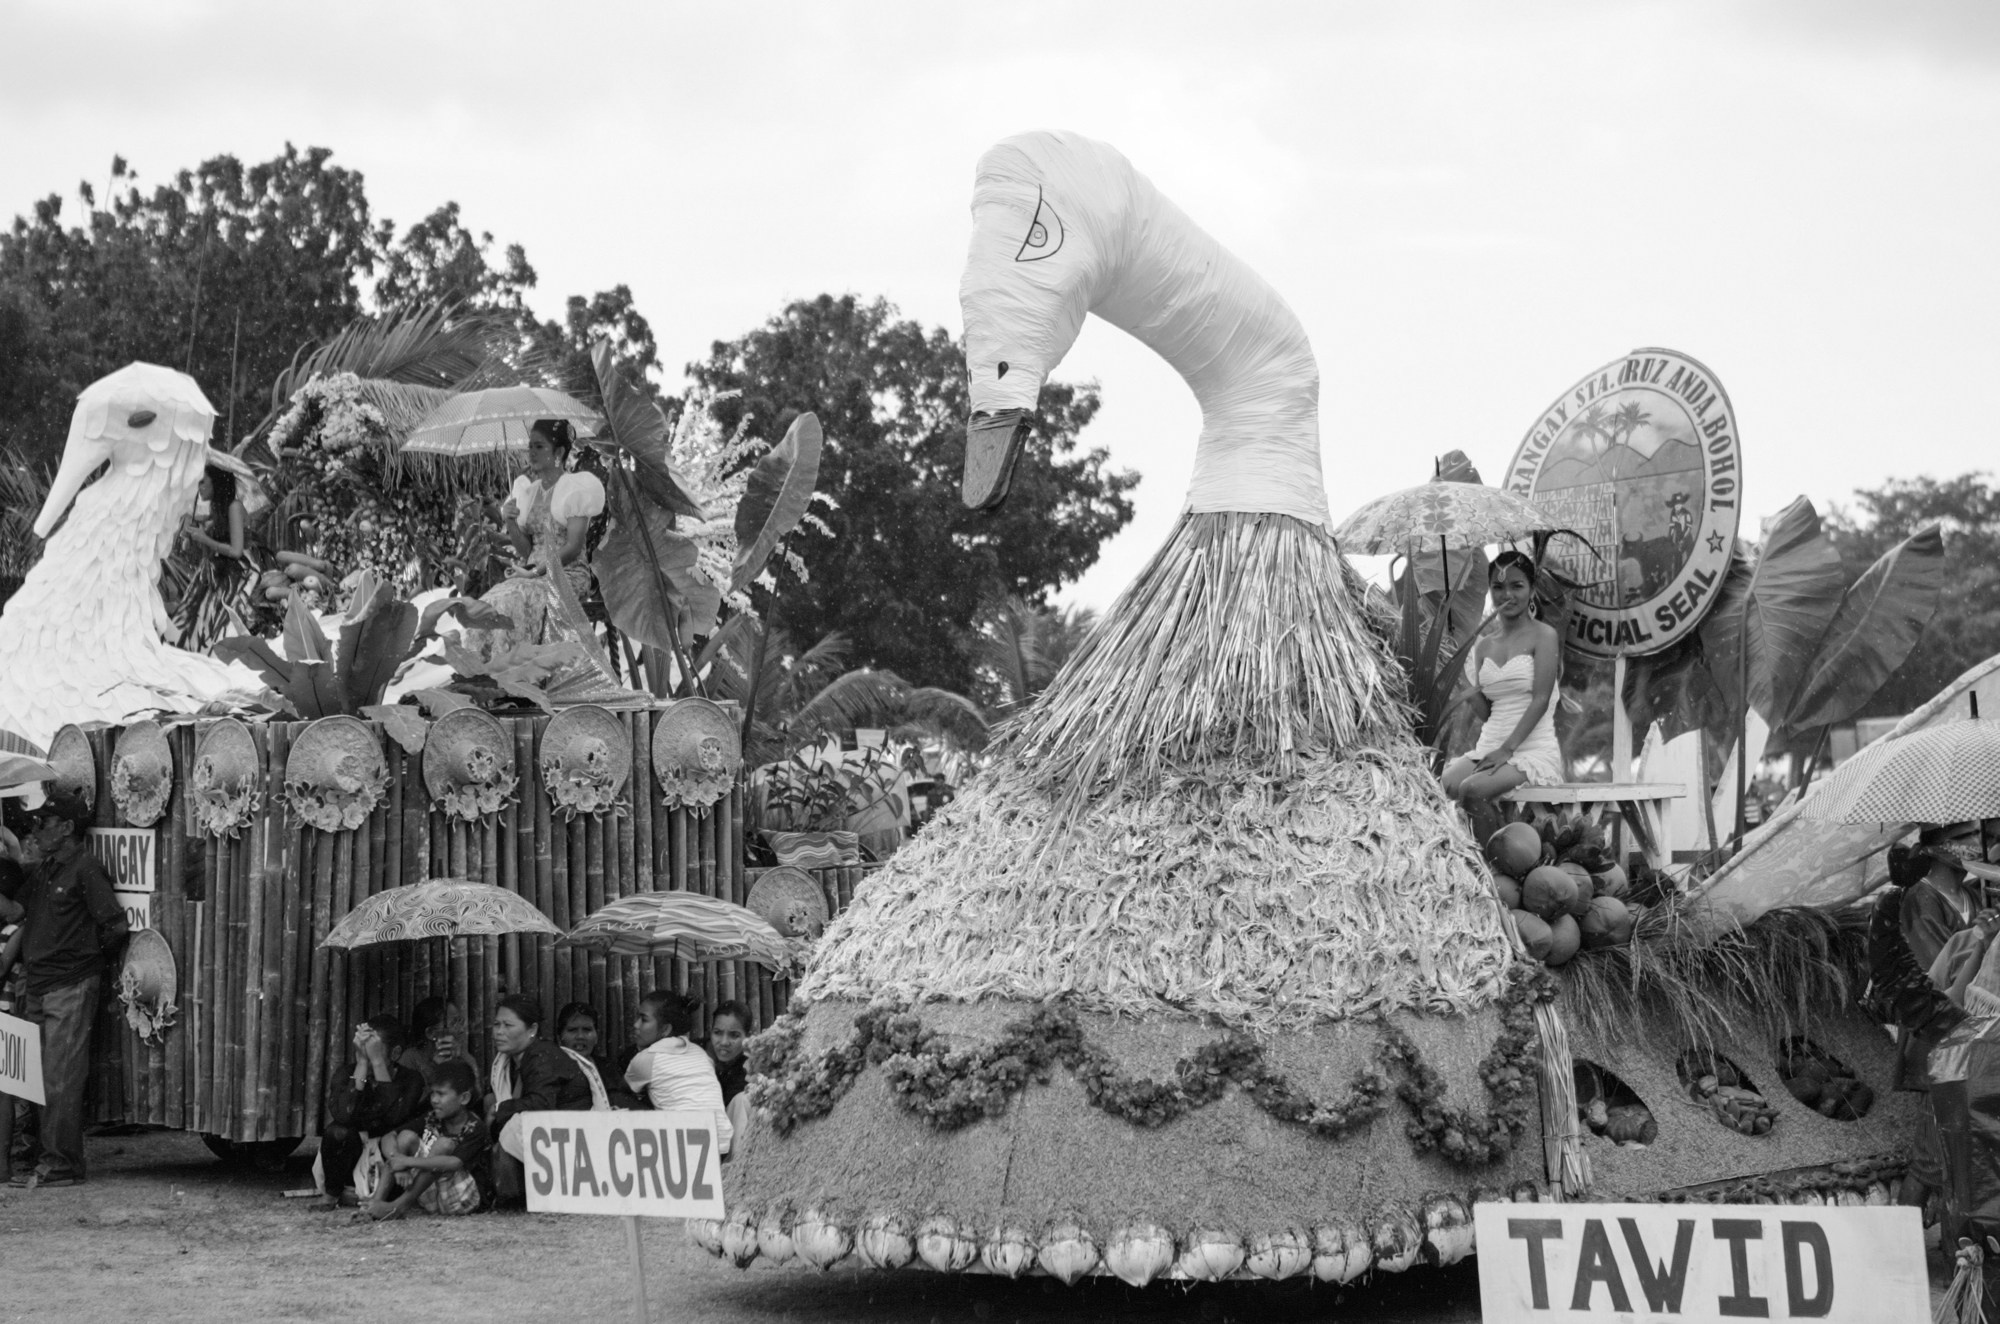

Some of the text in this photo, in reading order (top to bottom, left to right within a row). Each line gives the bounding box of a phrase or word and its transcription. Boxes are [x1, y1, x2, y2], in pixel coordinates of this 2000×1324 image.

[1510, 402, 1568, 498] RANGAY
[1575, 373, 1615, 408] STA.
[1617, 358, 1669, 386] CRUZ
[1702, 414, 1735, 513] BOHOL
[1655, 568, 1717, 632] SEAL
[589, 921, 649, 932] AVON
[1507, 1217, 1834, 1318] TAWID
